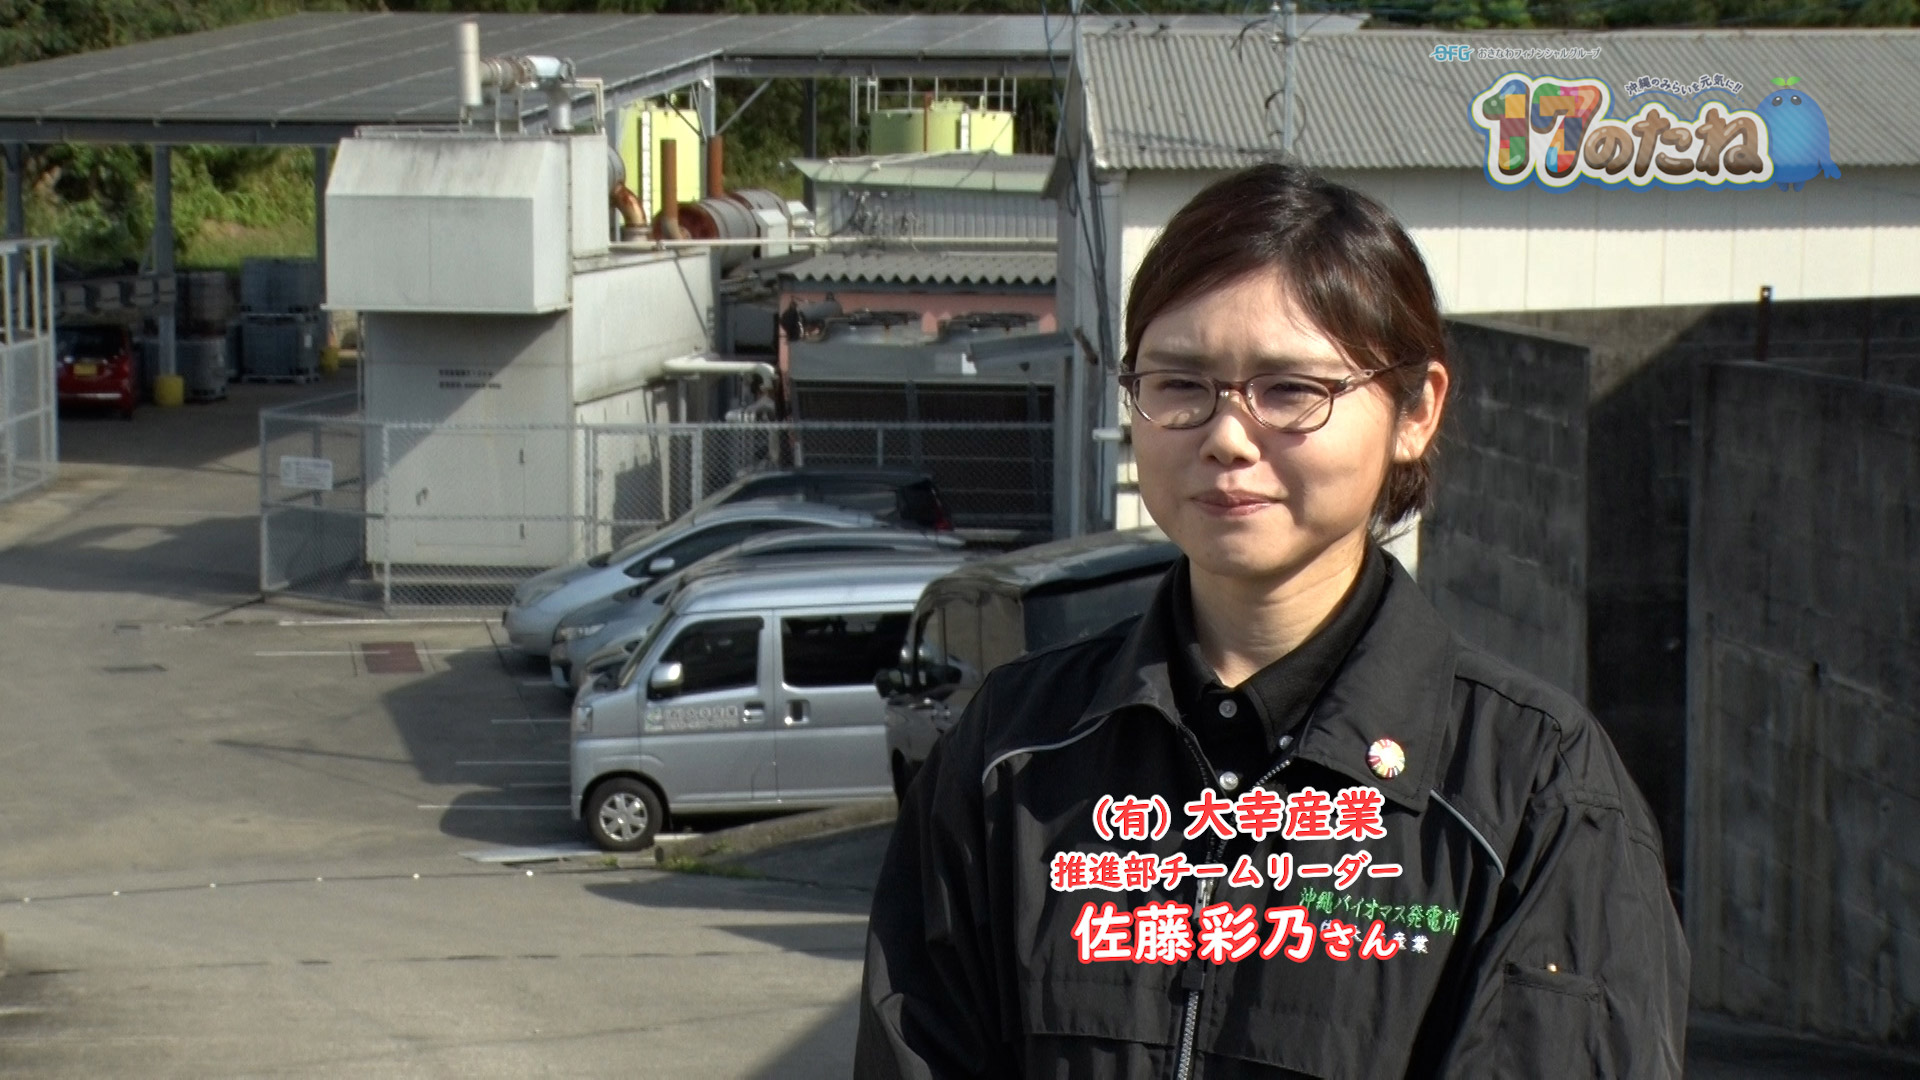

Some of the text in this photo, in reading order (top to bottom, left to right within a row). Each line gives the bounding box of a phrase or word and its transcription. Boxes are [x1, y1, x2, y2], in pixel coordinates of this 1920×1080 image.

[1298, 885, 1461, 936] 沖縄バイオマス発電所
